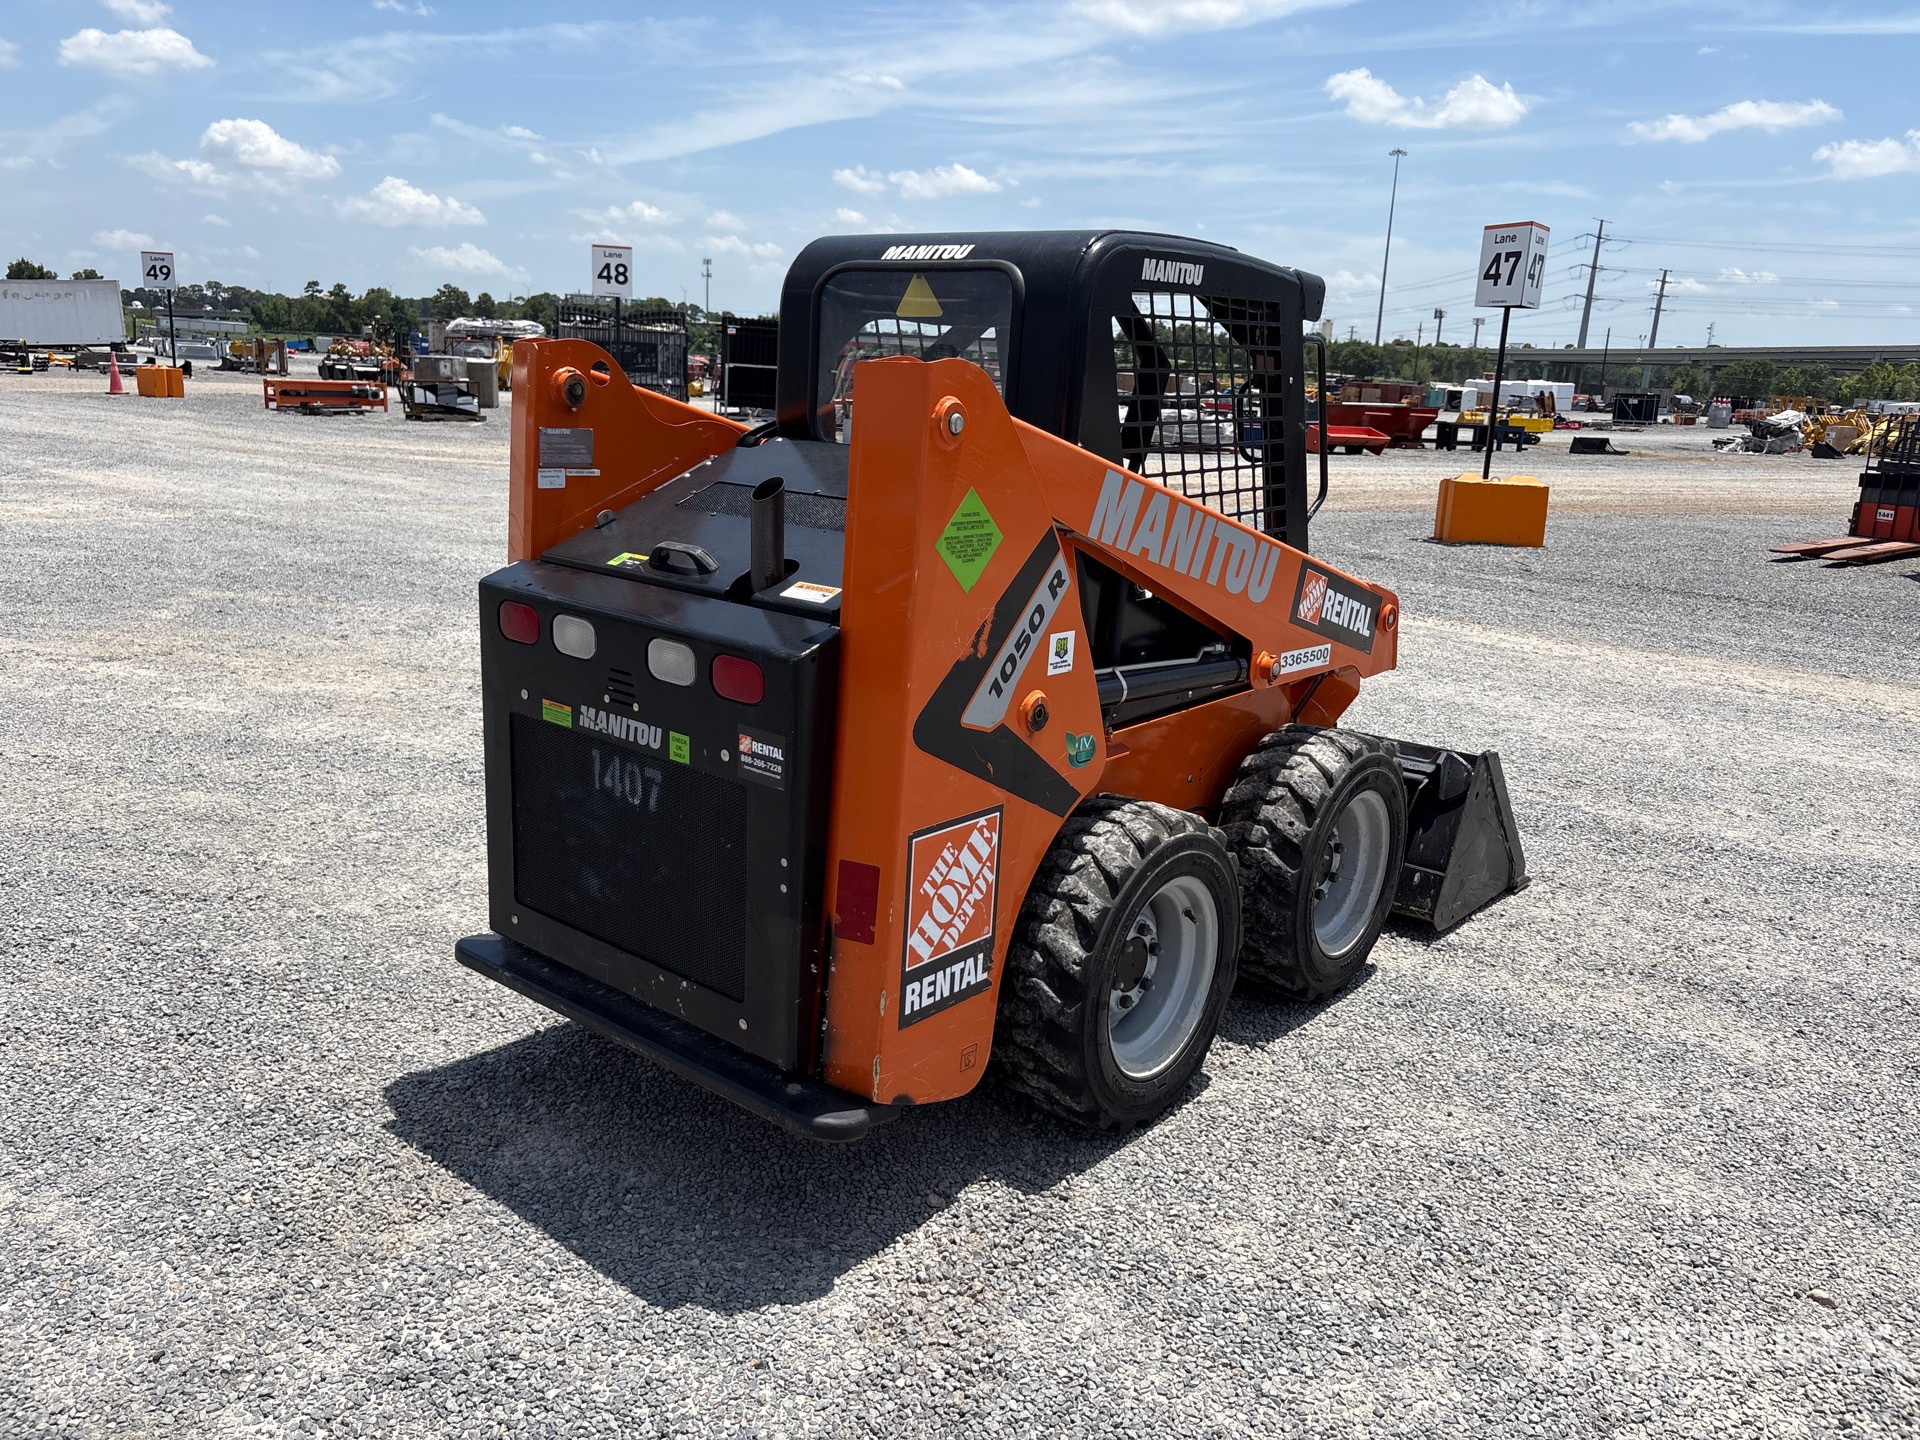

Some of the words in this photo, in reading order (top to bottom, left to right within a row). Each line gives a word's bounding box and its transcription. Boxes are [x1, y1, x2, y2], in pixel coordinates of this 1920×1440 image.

[604, 251, 622, 259] Lane
[880, 244, 975, 260] MANITOU
[1494, 234, 1518, 244] Lane
[1535, 233, 1545, 246] Lane
[145, 264, 171, 281] 49
[597, 263, 629, 285] 48
[1141, 258, 1205, 286] MANITOU
[1483, 251, 1523, 287] 47
[1528, 252, 1545, 290] 47
[1087, 469, 1281, 603] MANITOU
[1298, 576, 1328, 618] HOME
[1322, 588, 1371, 637] RENTAL
[989, 603, 1046, 699] 1050
[1048, 568, 1067, 601] R
[1056, 638, 1068, 651] 811
[1281, 647, 1329, 668] 3365500
[579, 704, 662, 749] MANITOU
[672, 736, 687, 745] CHECK
[741, 754, 781, 773] 888-266-7228
[752, 741, 784, 761] RENTAL
[592, 748, 663, 813] 1407
[919, 842, 958, 899] THE
[908, 818, 999, 963] HOME
[942, 861, 995, 951] DEPOT
[904, 953, 989, 1015] RENTAL
